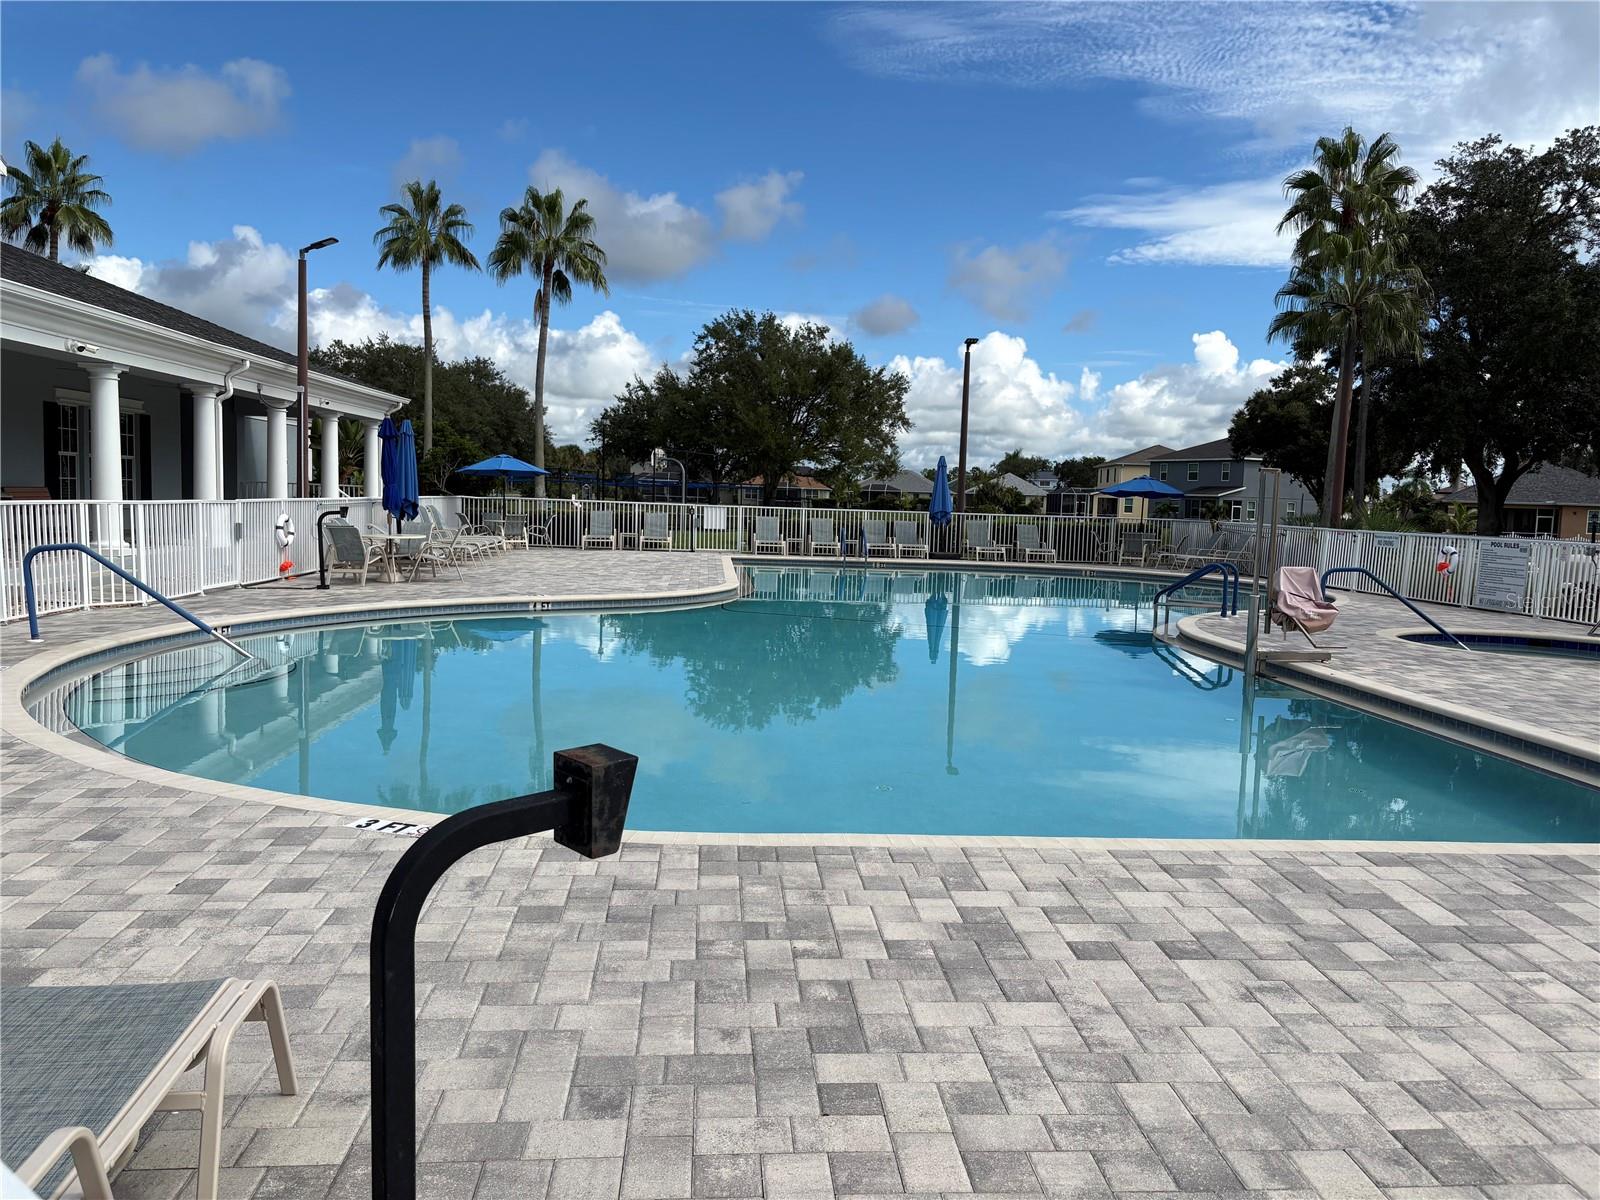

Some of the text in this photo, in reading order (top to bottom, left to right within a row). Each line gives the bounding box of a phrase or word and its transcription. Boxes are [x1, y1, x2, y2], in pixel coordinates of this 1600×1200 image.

[221, 625, 231, 635] FT
[355, 819, 418, 833] 3 FT
